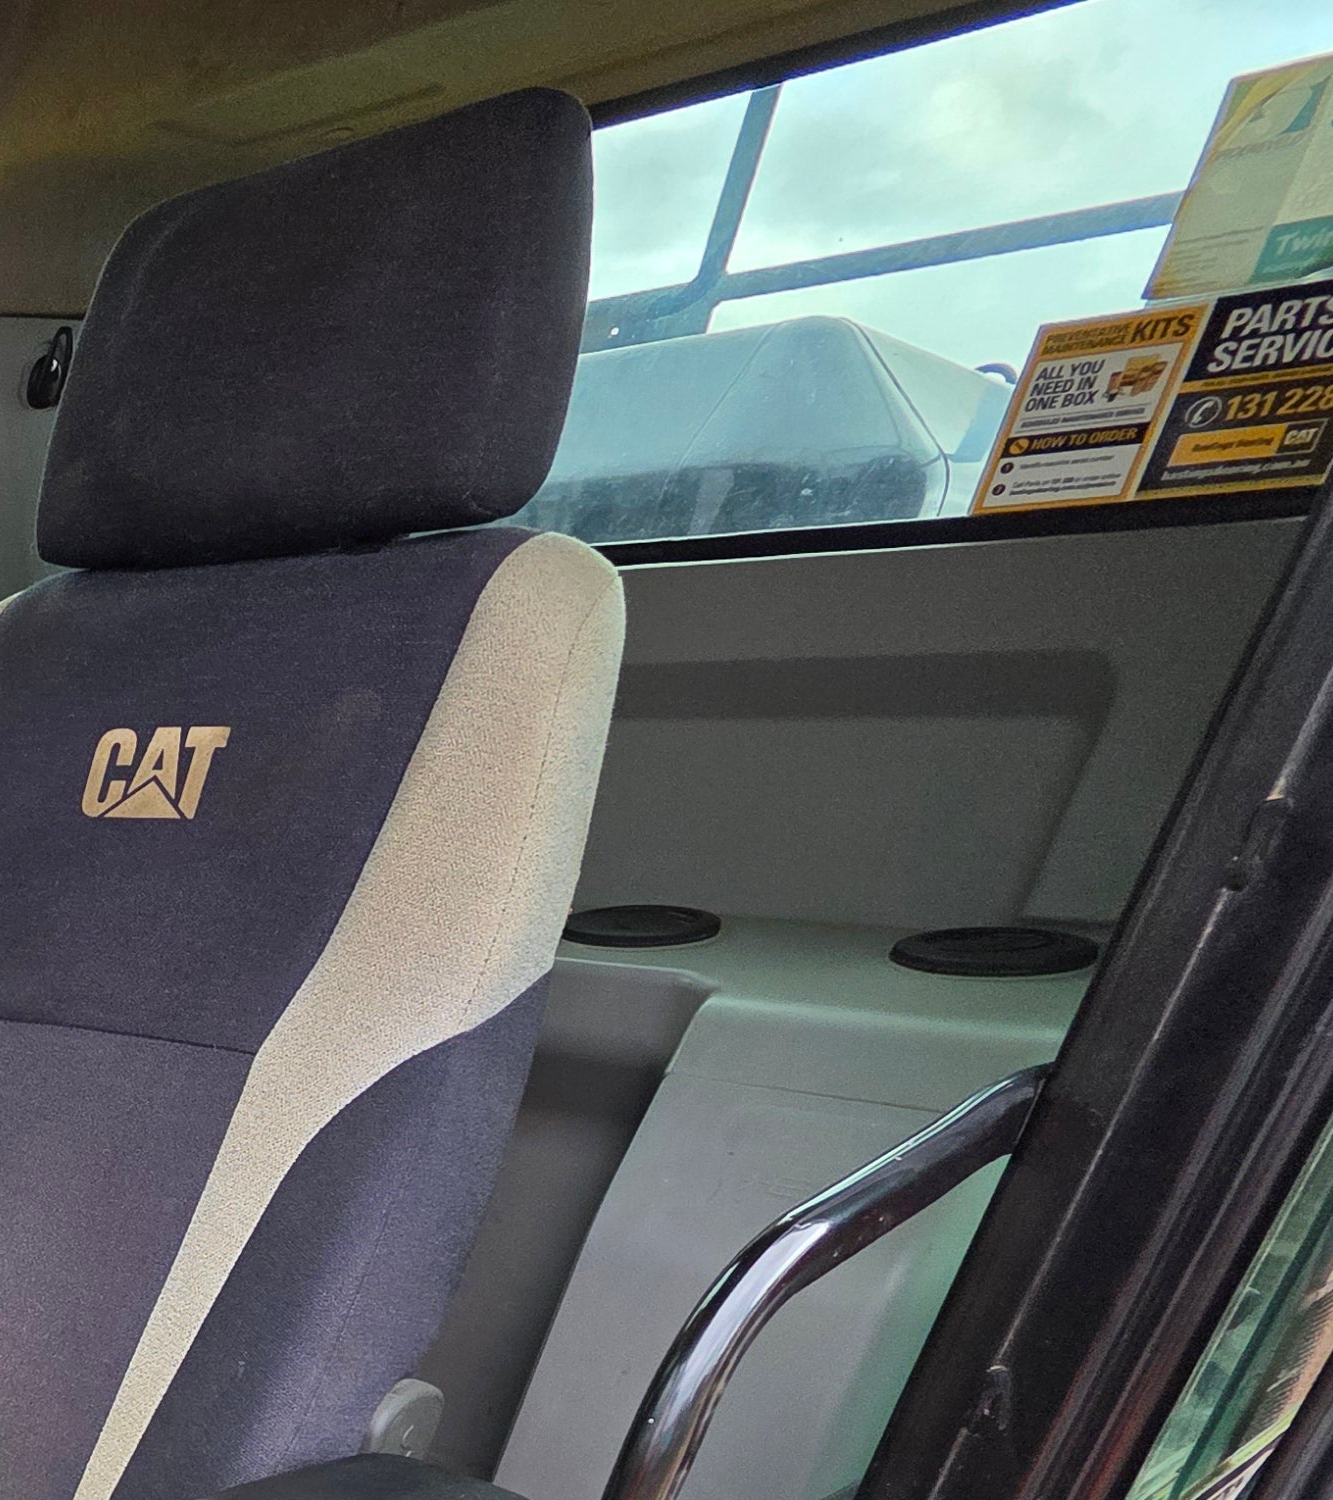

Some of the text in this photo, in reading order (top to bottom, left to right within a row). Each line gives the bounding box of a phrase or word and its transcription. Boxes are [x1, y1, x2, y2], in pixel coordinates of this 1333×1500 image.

[1131, 314, 1194, 343] KITS
[1207, 329, 1333, 373] SERVIC
[1036, 359, 1106, 381] ALL YOU
[1030, 376, 1099, 397] NEED IN
[1025, 390, 1099, 412] ONE BOX
[1225, 391, 1278, 421] 131
[1031, 428, 1138, 450] HOW TO ORDER
[1284, 428, 1318, 445] CAT
[82, 726, 231, 820] CAT
